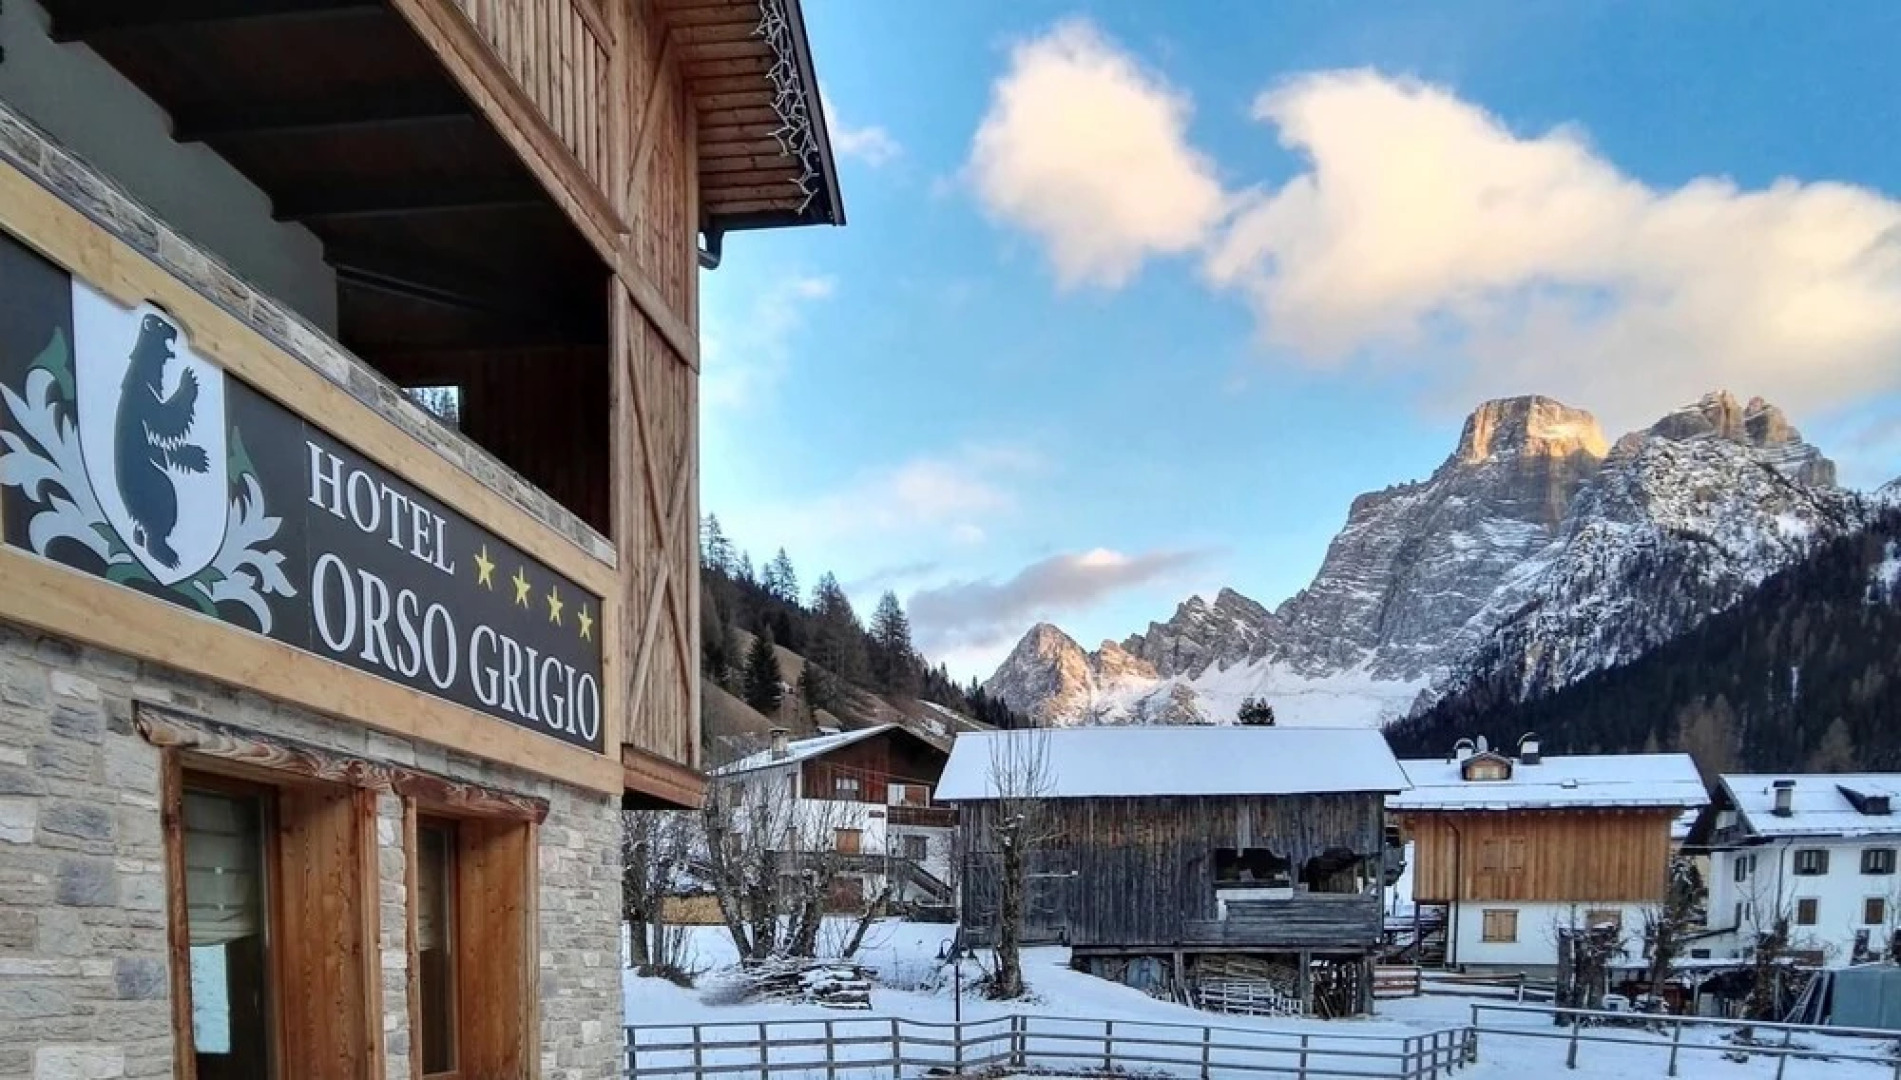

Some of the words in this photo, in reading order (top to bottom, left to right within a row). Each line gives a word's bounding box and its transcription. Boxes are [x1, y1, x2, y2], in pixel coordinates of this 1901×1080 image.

[305, 440, 455, 575] HOTEL
[312, 552, 457, 689] ORSO
[469, 624, 600, 741] GRIGIO
